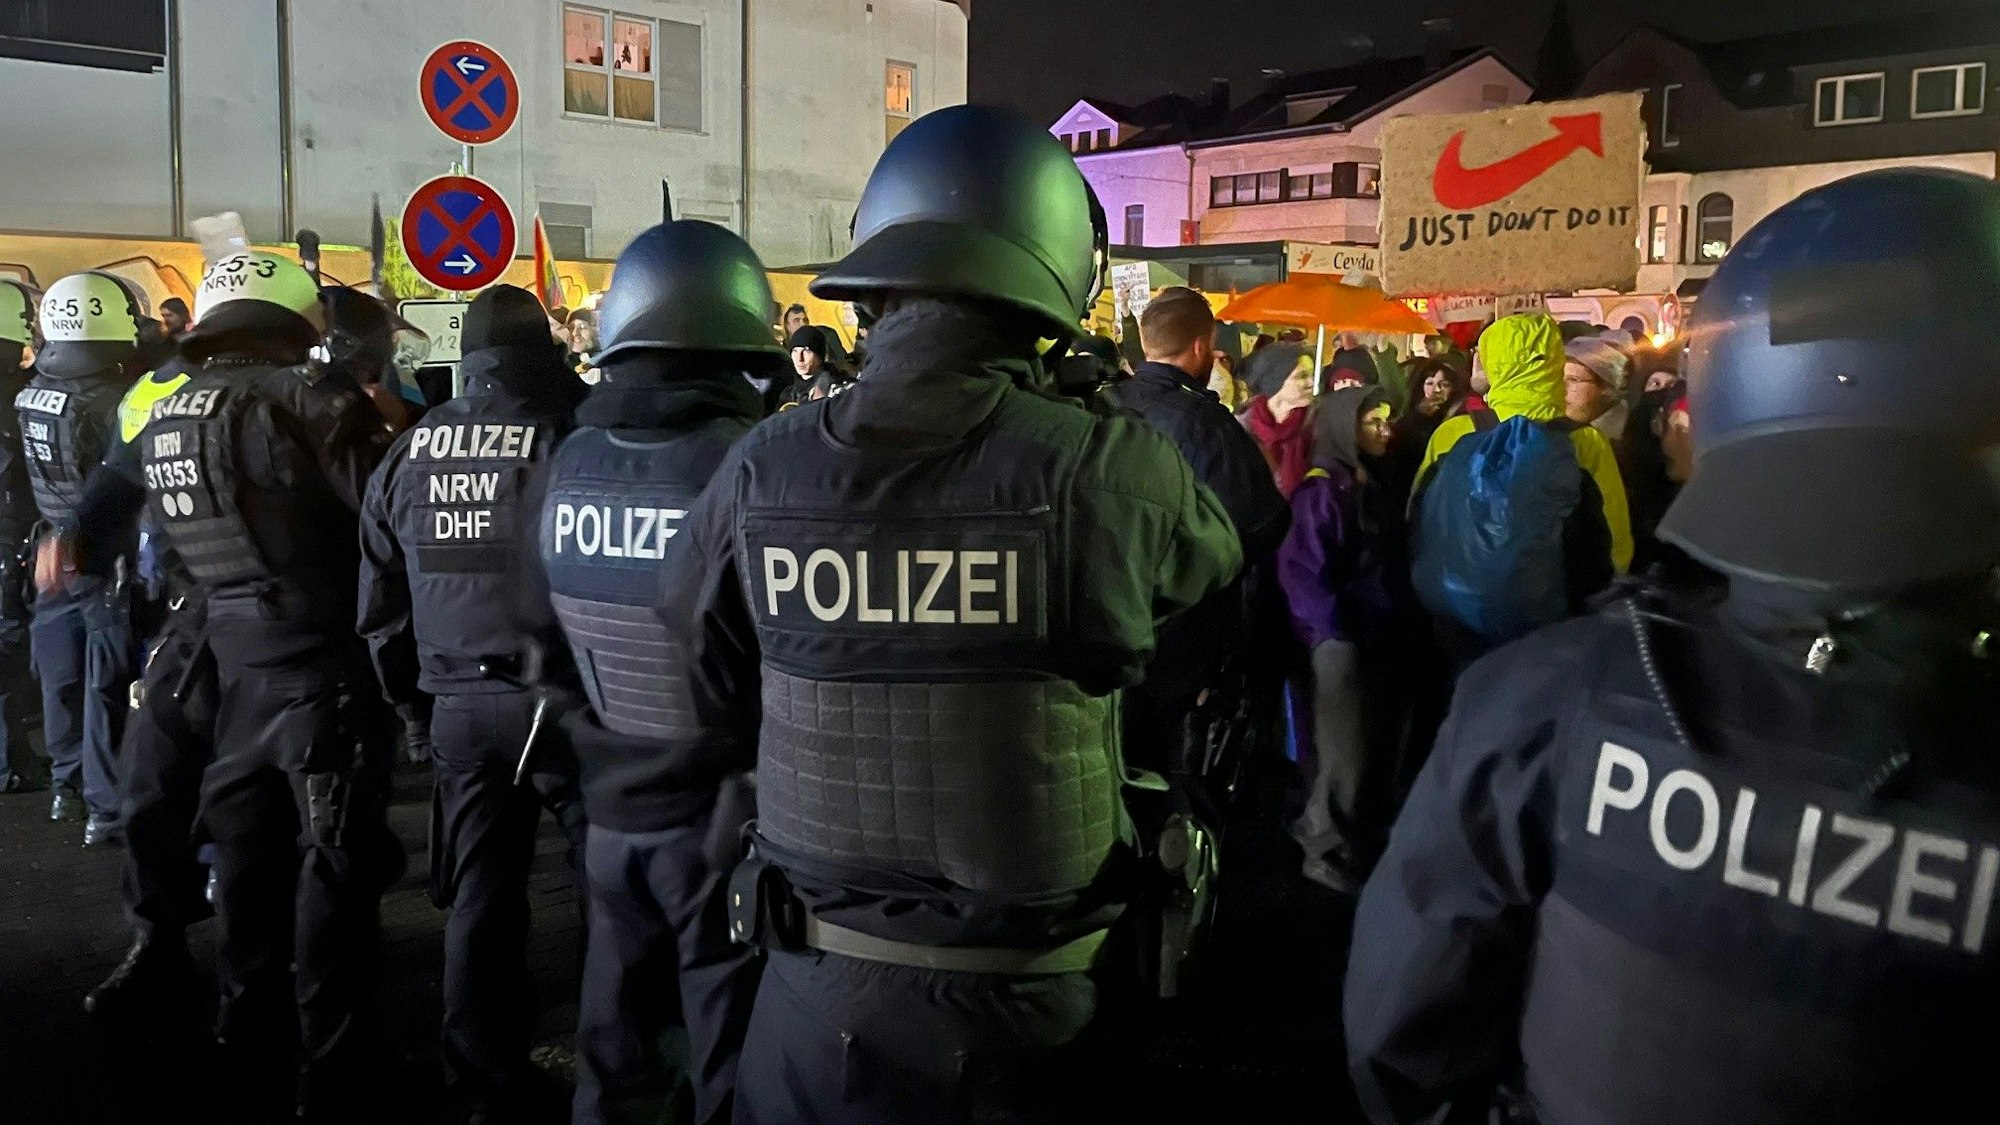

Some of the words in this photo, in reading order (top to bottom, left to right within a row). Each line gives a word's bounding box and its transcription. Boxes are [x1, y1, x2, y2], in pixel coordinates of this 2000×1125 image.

[1399, 213, 1475, 251] JUST
[1488, 206, 1559, 237] DON'T
[1567, 207, 1601, 230] DO
[1608, 206, 1631, 226] IT
[205, 274, 248, 292] NRW
[1400, 297, 1429, 314] KE
[52, 319, 84, 330] NRW
[27, 421, 48, 441] RW
[154, 431, 181, 458] NRW
[408, 424, 535, 459] POLIZEI
[145, 459, 198, 489] 31353
[429, 472, 499, 503] NRW
[435, 510, 491, 540] DHF
[555, 503, 689, 560] POLIZE
[763, 546, 1018, 624] POLIZEI
[1586, 741, 2000, 954] POLIZEI
